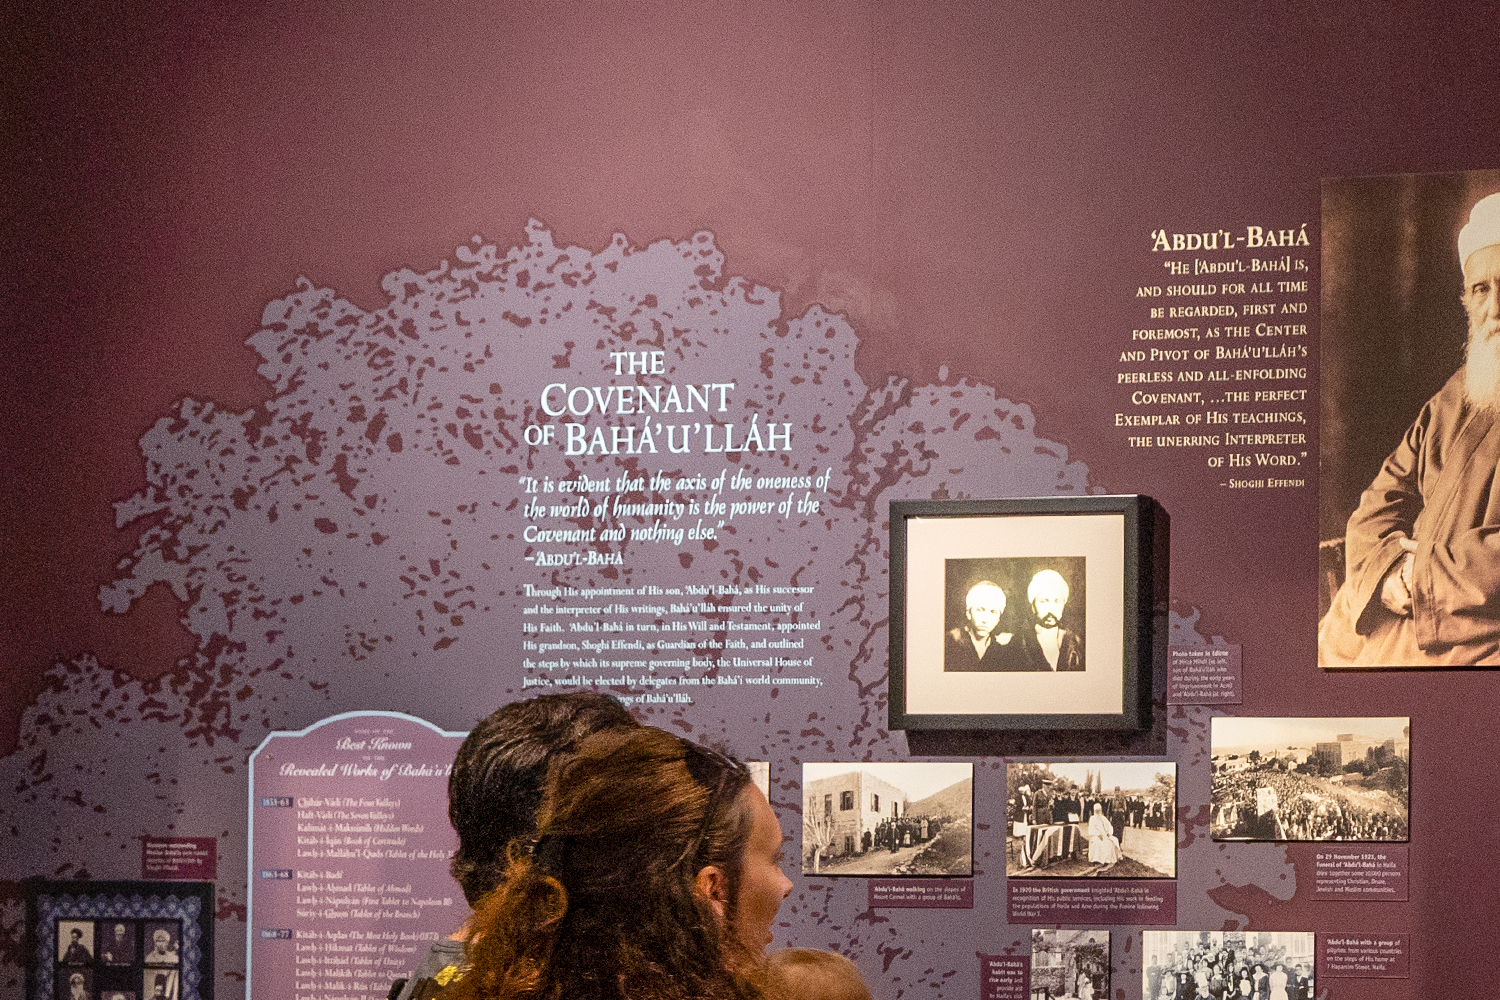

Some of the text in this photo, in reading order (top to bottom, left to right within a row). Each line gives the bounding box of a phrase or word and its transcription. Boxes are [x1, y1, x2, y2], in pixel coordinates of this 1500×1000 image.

[1164, 261, 1190, 275] "HE
[1295, 259, 1309, 273] IS,
[1136, 281, 1308, 298] AND SHOULD FOR ALL TIME
[1150, 302, 1308, 319] BE REGARDED, FIRST AND
[1132, 322, 1308, 342] FOREMOST, AS THE CENTER
[610, 351, 666, 375] THE
[1119, 349, 1146, 362] AND
[1150, 348, 1188, 361] PIVOT
[1193, 348, 1210, 360] OF
[1117, 367, 1307, 384] PEERLESS AND ALL-ENFOLDING
[540, 382, 734, 417] COVENANT
[1132, 390, 1205, 406] COVENANT,
[1254, 389, 1308, 402] PERFECT
[1115, 411, 1306, 427] EXEMPLAR OF HIS TEACHINGS,
[523, 413, 794, 456] OF BAHÁ'U'LLÁH
[1128, 432, 1306, 448] THE UNERRING INTERPRETER
[1207, 451, 1308, 468] OF HIS WORD."
[519, 467, 832, 494] "It is evident that the axis of the oneness of
[1267, 477, 1305, 488] EFFENDI
[524, 491, 820, 522] the world of humanity is the power of the
[523, 519, 725, 545] Covenant and nothing else."
[523, 584, 561, 599] Through
[564, 586, 578, 596] His
[581, 586, 634, 599] appointment
[637, 586, 647, 595] of
[649, 586, 663, 595] His
[665, 587, 683, 596] son,
[756, 585, 770, 594] His
[773, 586, 814, 594] successor
[523, 604, 538, 614] and
[540, 604, 553, 614] the
[556, 605, 601, 618] interpreter
[603, 604, 612, 614] of
[615, 604, 629, 614] His
[631, 604, 668, 617] writings,
[718, 603, 751, 613] ensured
[754, 603, 767, 612] the
[770, 603, 792, 615] unity
[794, 602, 804, 612] of
[523, 623, 537, 632] His
[541, 622, 565, 632] Faith.
[626, 622, 634, 631] in
[637, 623, 660, 633] turn,
[662, 622, 670, 631] in
[672, 622, 687, 631] His
[688, 621, 707, 631] Will
[709, 621, 725, 631] and
[727, 621, 775, 632] Testament,
[777, 620, 820, 633] appointed
[523, 641, 537, 650] His
[539, 640, 580, 653] grandson,
[582, 640, 609, 653] Shoghi
[611, 640, 645, 650] Effendi,
[657, 640, 695, 649] Guardian
[698, 640, 707, 649] of
[709, 639, 723, 649] the
[725, 639, 749, 650] Faith,
[751, 638, 767, 649] and
[769, 638, 804, 649] outlined
[523, 657, 813, 671] the steps by which its supreme governing body, the Universal House of
[523, 677, 553, 688] Justice,
[554, 675, 581, 686] would
[583, 676, 593, 686] be
[594, 675, 625, 686] elected
[627, 676, 637, 689] by
[639, 675, 677, 688] delegates
[679, 676, 700, 685] from
[702, 676, 716, 685] the
[745, 675, 771, 685] world
[772, 676, 823, 688] community,
[636, 694, 645, 703] of
[335, 737, 412, 751] Best Known
[279, 762, 339, 777] Revealed
[340, 763, 379, 777] Works
[379, 764, 397, 781] of
